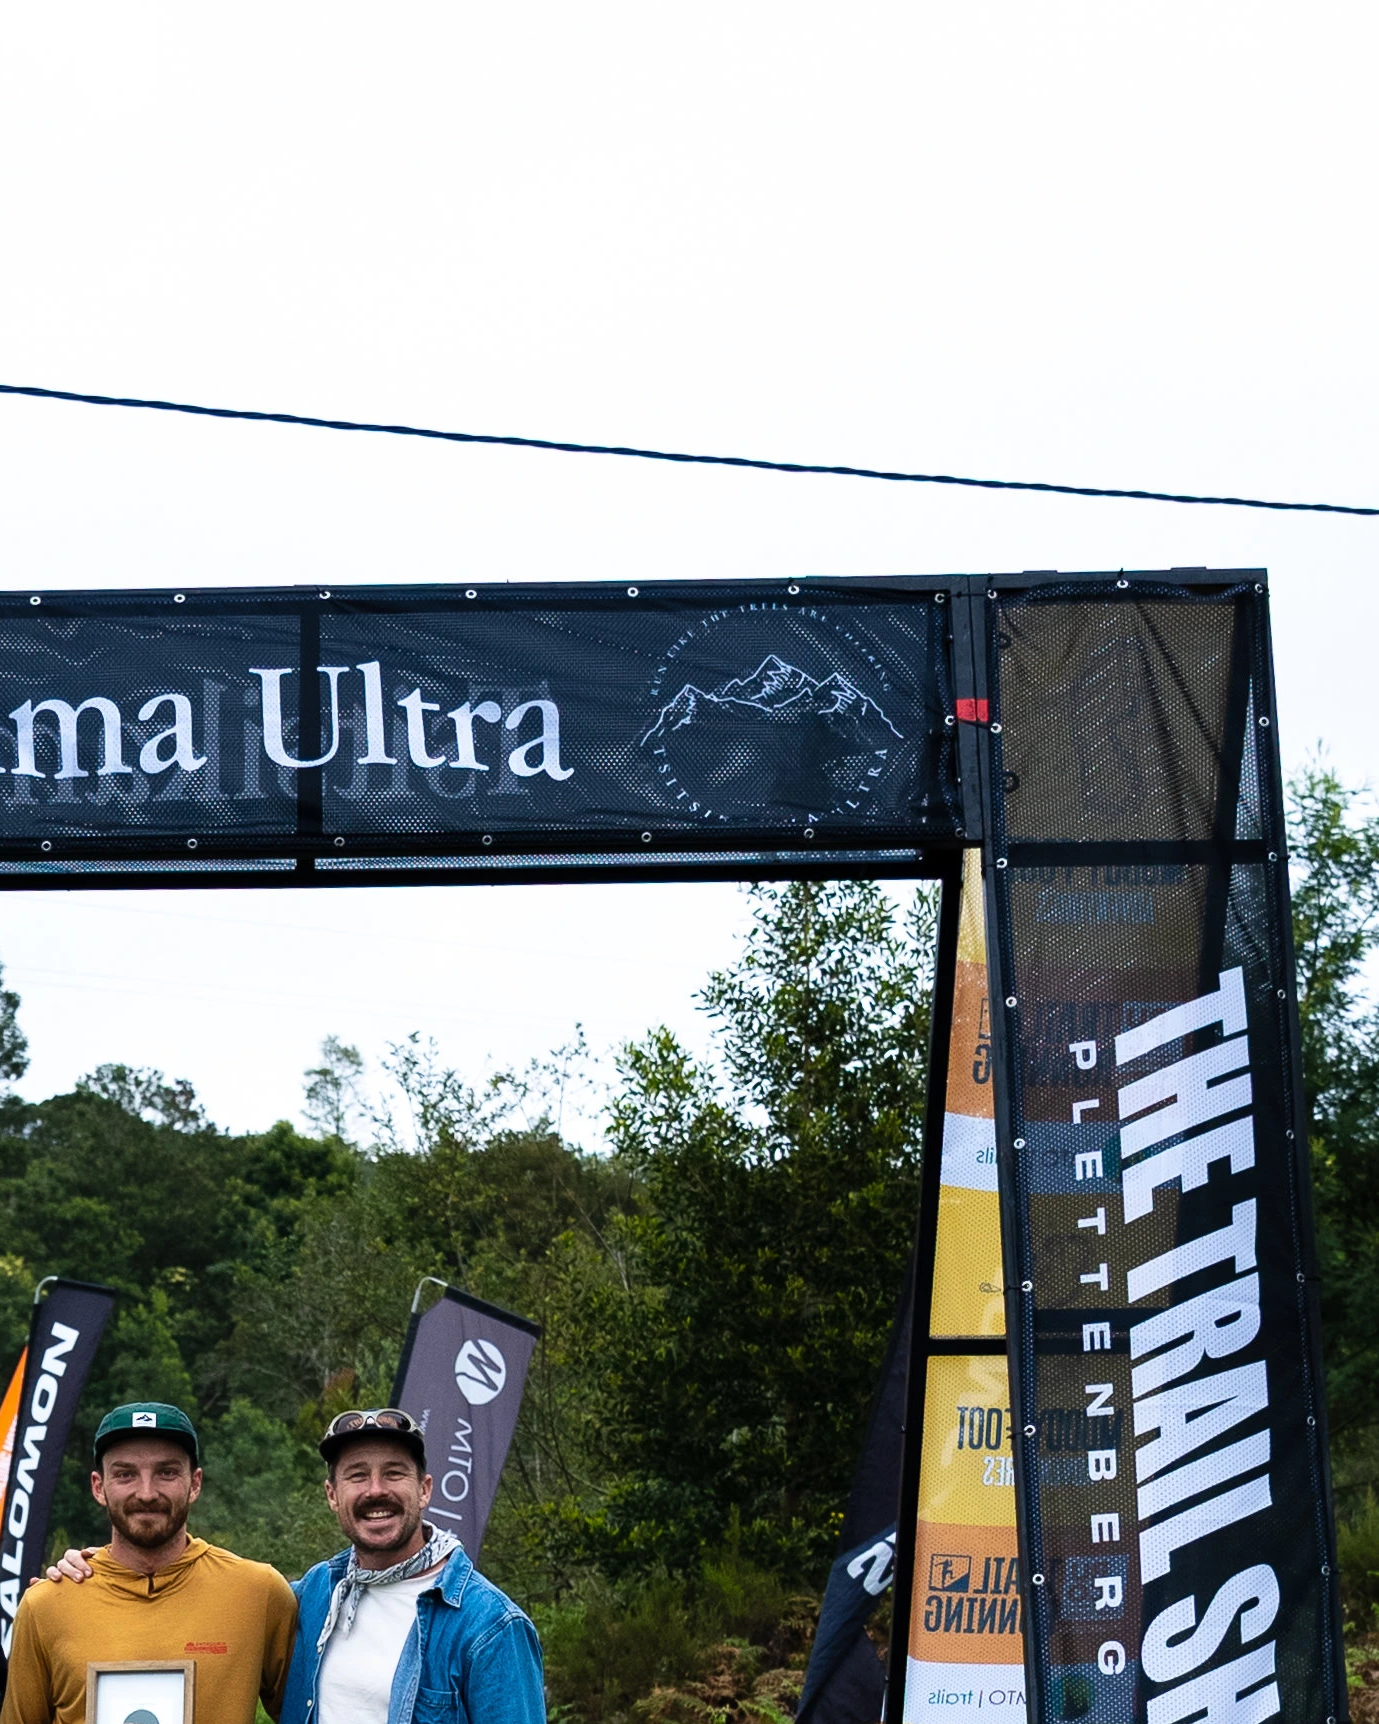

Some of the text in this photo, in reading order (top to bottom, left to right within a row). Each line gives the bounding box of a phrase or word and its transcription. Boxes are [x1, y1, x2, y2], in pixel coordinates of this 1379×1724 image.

[248, 661, 575, 782] Ultra
[653, 748, 819, 823] TSITSIA
[1114, 966, 1256, 1225] THE
[1068, 1040, 1126, 1676] PLETTENBERG
[1127, 1197, 1273, 1585] TRAIL
[441, 1417, 473, 1502] MTO
